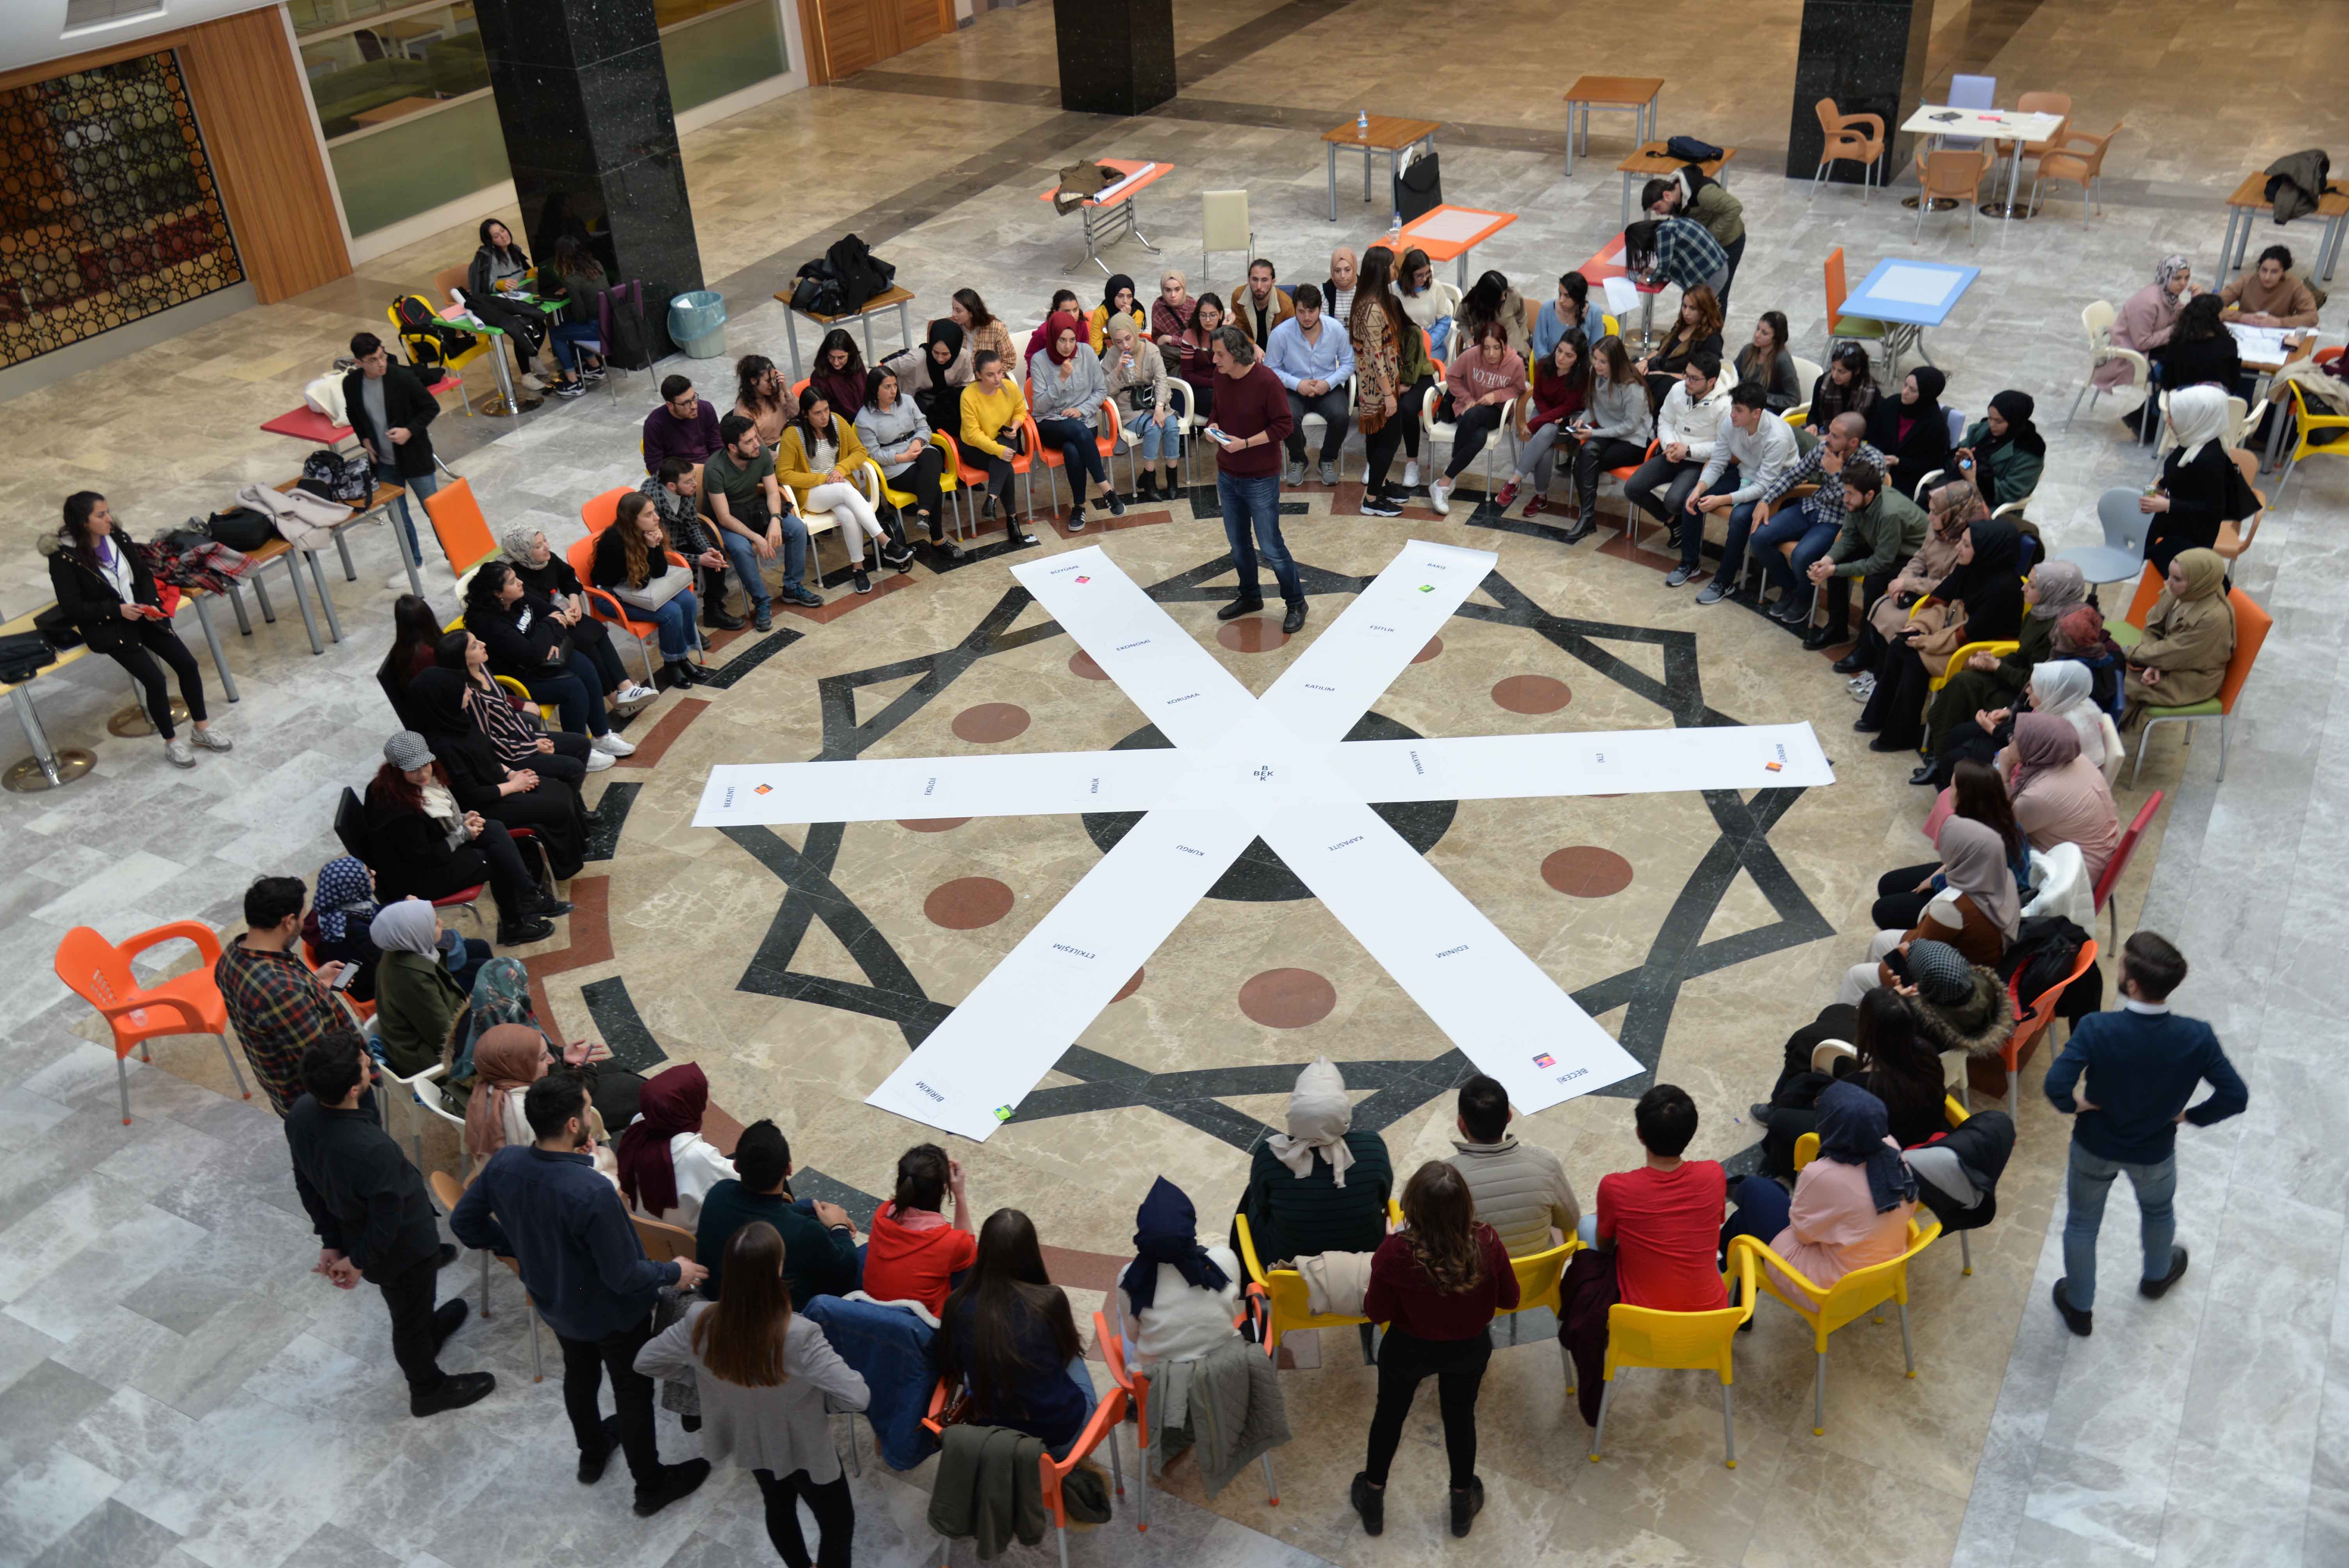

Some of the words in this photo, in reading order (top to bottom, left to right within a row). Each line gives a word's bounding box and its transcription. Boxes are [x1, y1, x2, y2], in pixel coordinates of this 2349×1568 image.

[1167, 693, 1200, 704] KORUMA
[1409, 751, 1424, 775] KALKINMA
[924, 778, 937, 795] EKOLOJİ
[1090, 778, 1100, 793] KİMLİK
[1176, 845, 1205, 856] KURGU
[1327, 836, 1364, 851] KAPASİTE
[1052, 943, 1096, 959] ETKİLEŞİM
[1435, 945, 1469, 959] EDİNİM
[1556, 1068, 1588, 1085] BECERİ
[915, 1081, 945, 1103] BİRİKİM
